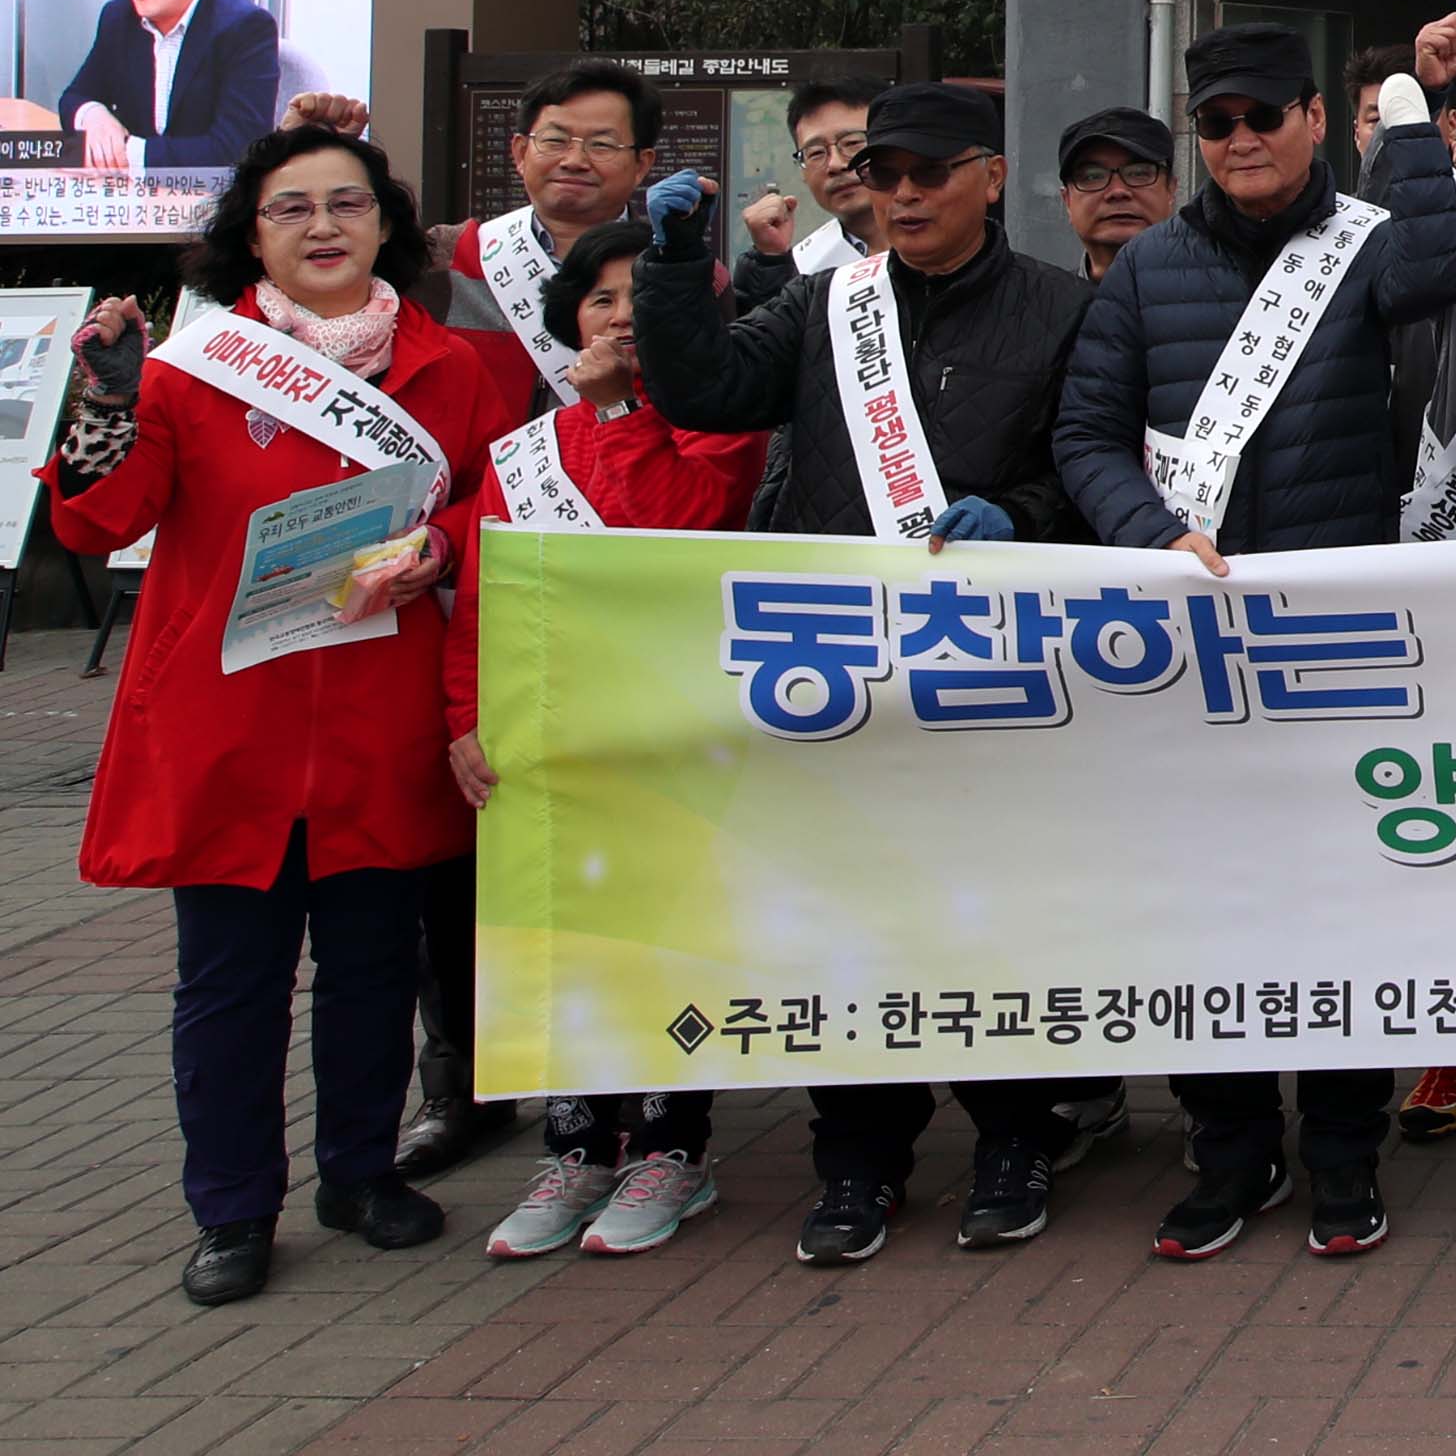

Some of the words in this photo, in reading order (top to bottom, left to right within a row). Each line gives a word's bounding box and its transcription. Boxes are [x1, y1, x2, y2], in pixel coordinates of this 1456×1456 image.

[612, 58, 695, 76] 천둘레길
[702, 57, 790, 76] 종합안내도
[18, 140, 63, 160] 있나요?
[16, 206, 31, 226] 수
[72, 206, 99, 226] 그런
[104, 205, 130, 227] 곳인
[135, 205, 148, 226] 것
[25, 176, 66, 200] 반나절
[71, 176, 98, 198] 정도
[134, 175, 161, 197] 정말
[165, 175, 206, 197] 맛있는
[202, 329, 332, 404] 음주운전
[846, 285, 892, 392] 무단횡단
[526, 420, 591, 528] 한국교통장
[863, 390, 925, 509] 평생눈물
[258, 522, 283, 543] 우리
[285, 515, 311, 534] 모두
[311, 495, 363, 523] 교통안전!
[728, 576, 1412, 728] 동참하는
[719, 994, 829, 1056] 주관
[877, 982, 1351, 1048] 한국교통장애인협회
